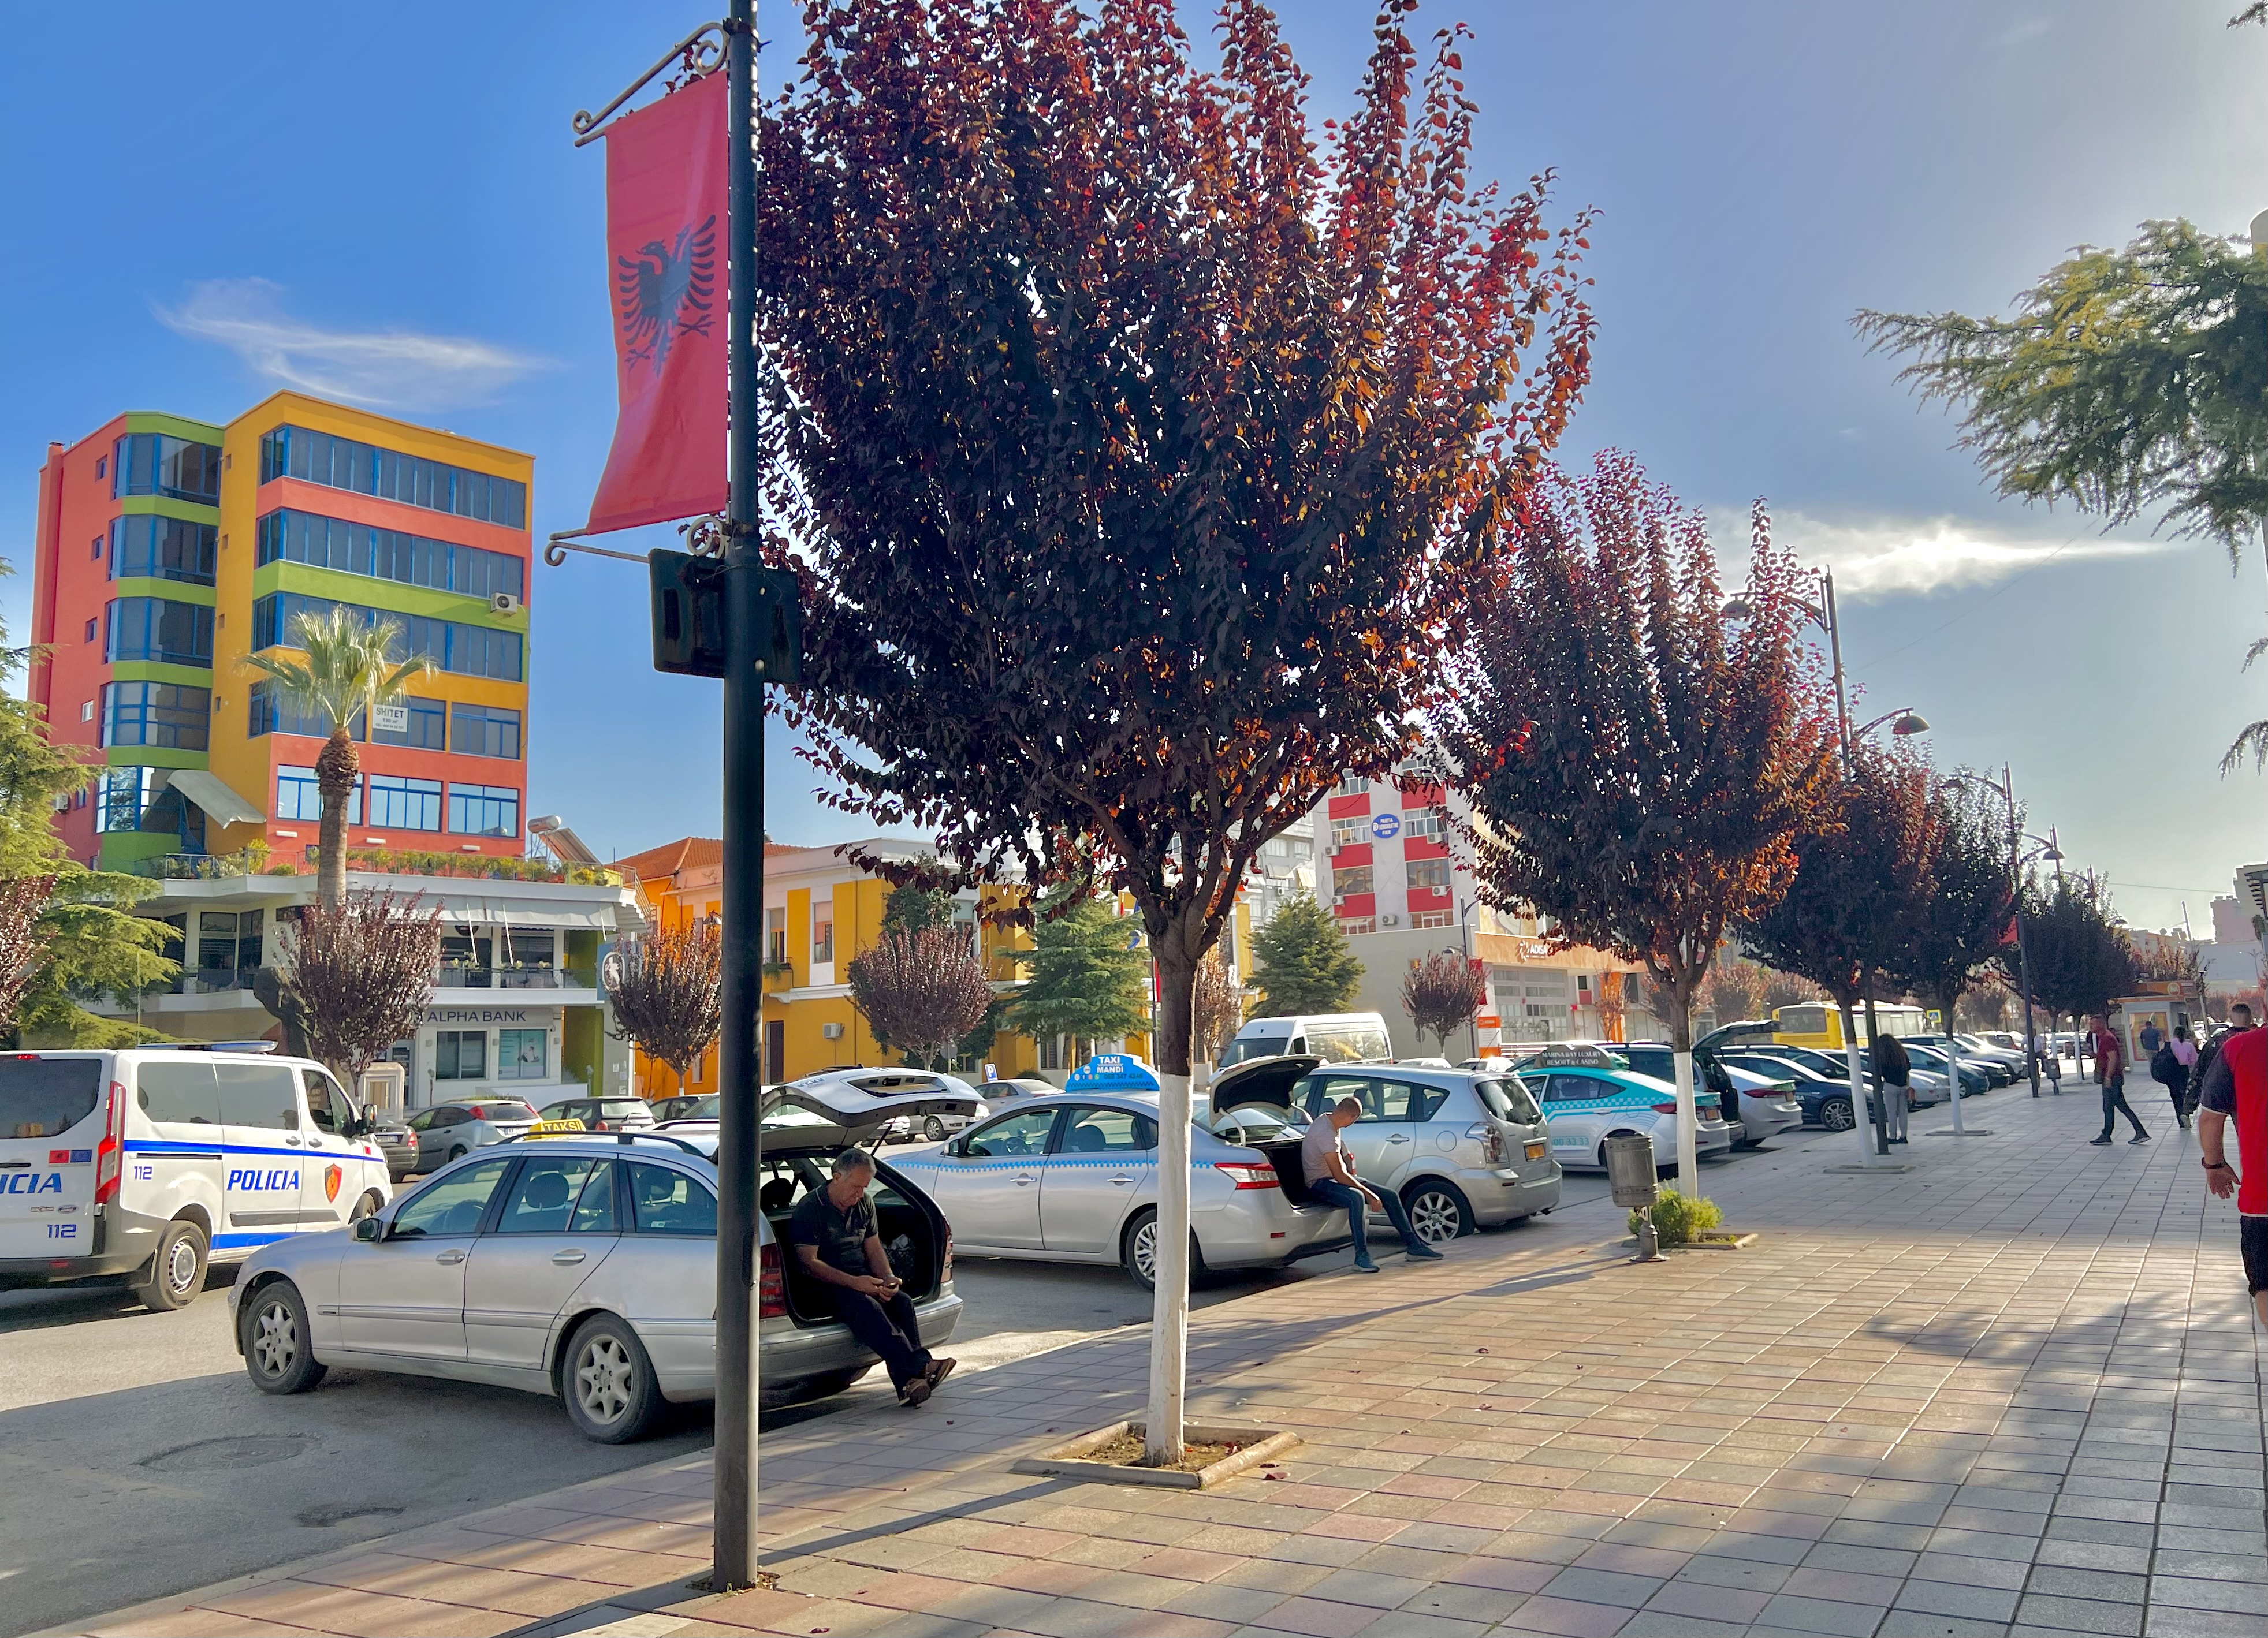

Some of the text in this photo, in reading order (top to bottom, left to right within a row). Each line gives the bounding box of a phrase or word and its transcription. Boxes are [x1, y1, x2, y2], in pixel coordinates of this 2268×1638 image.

[376, 707, 404, 718] SHITET
[427, 1010, 526, 1022] ALPHA BANK
[987, 1065, 994, 1077] P
[133, 1166, 153, 1180] 112
[226, 1170, 300, 1191] POLICIA
[47, 1224, 77, 1238] 112
